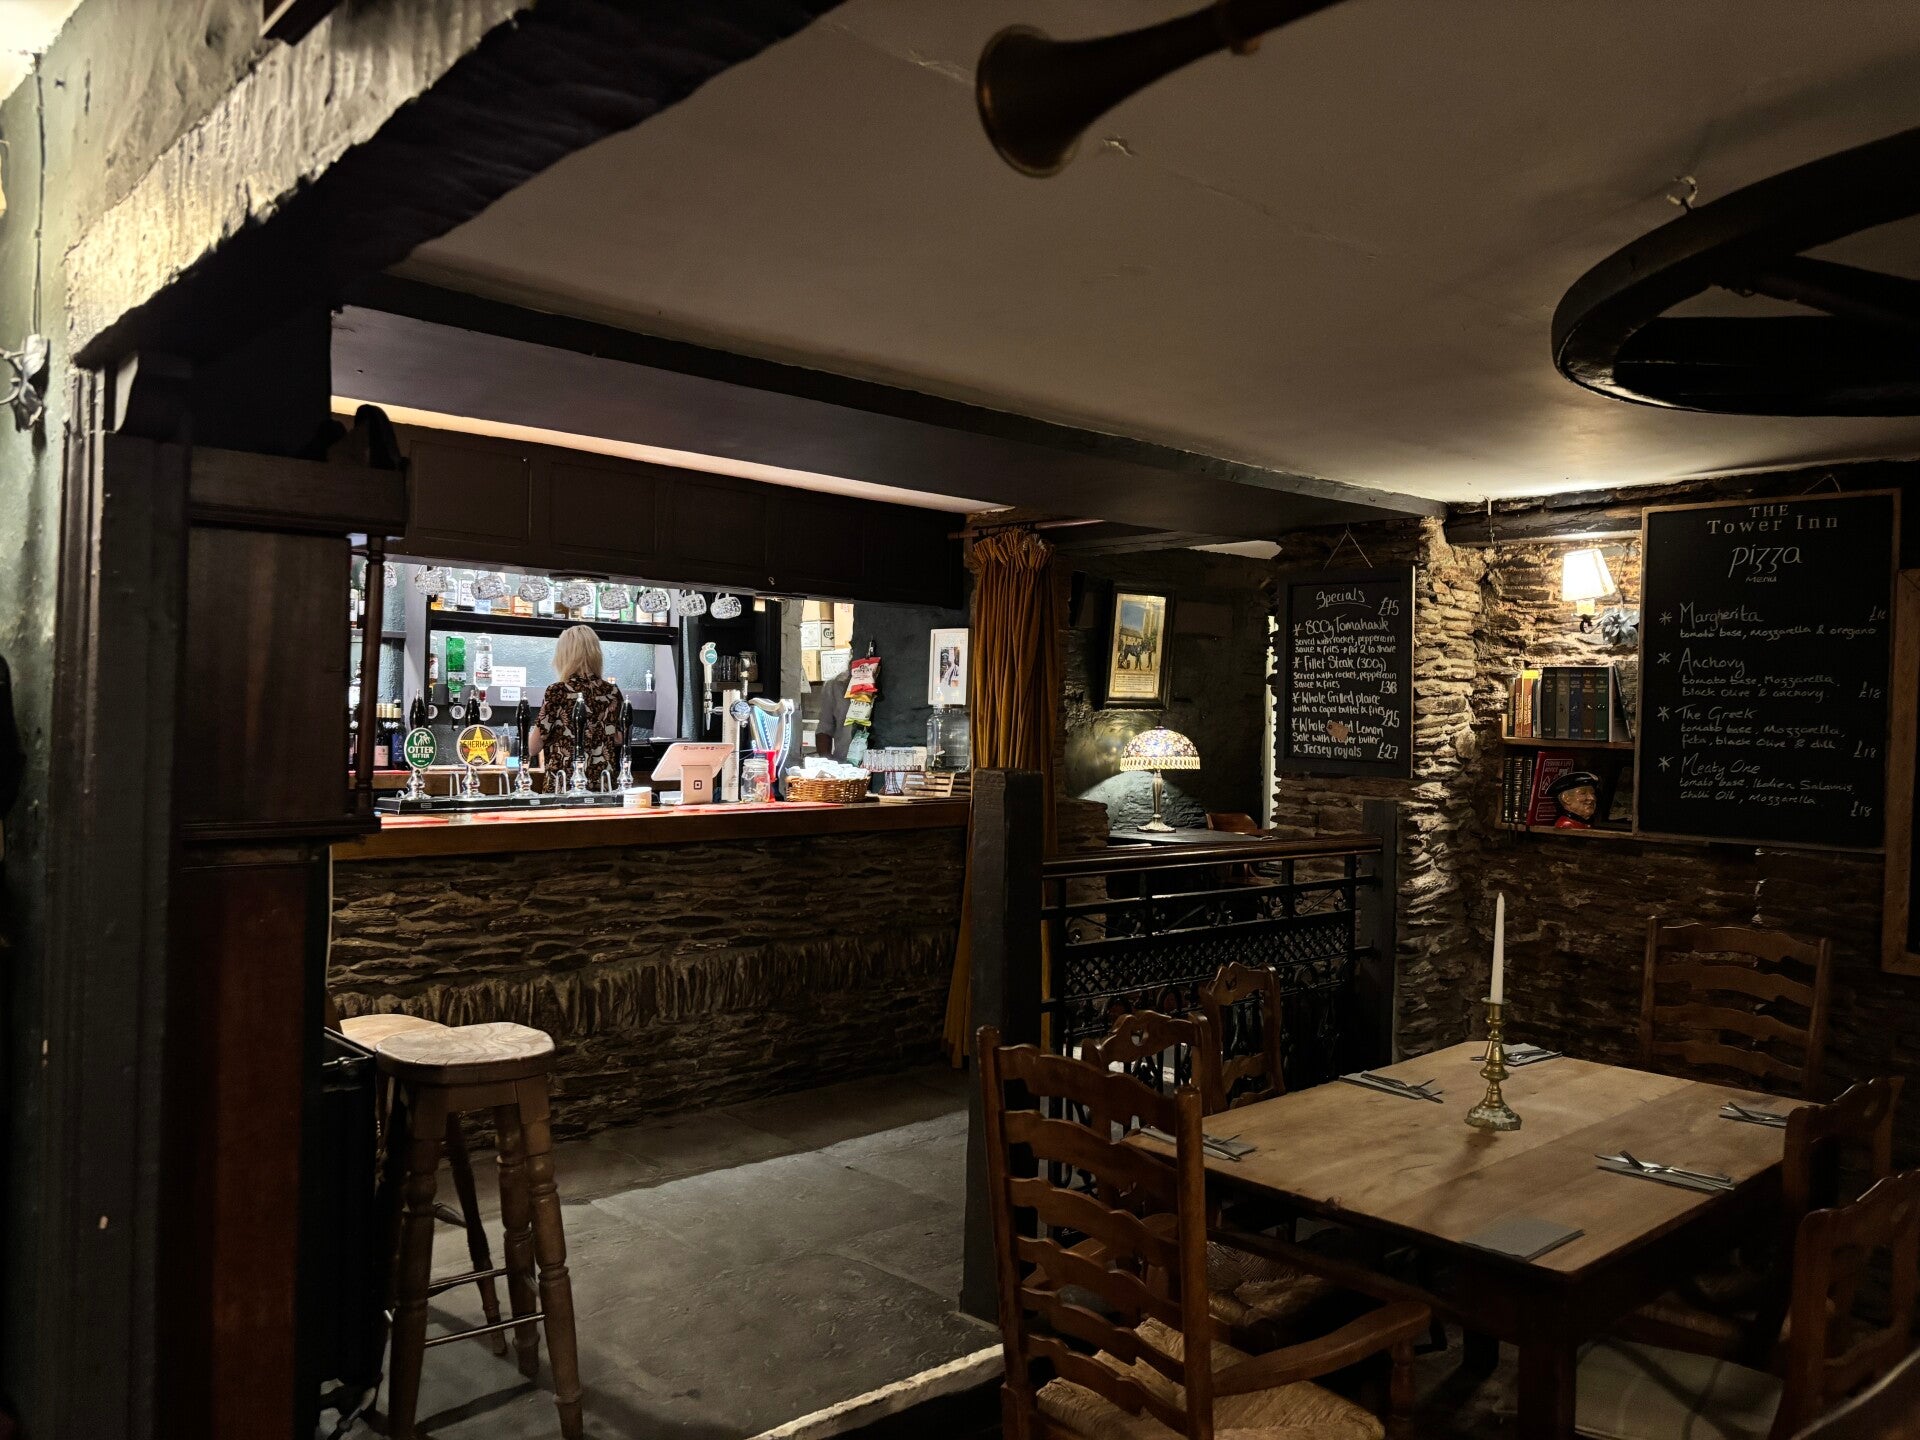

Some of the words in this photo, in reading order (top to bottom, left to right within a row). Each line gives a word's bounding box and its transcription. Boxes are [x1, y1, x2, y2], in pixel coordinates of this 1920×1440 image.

[1749, 505, 1789, 518] THE
[1707, 519, 1782, 534] Tower
[1796, 515, 1838, 530] Inn
[1728, 544, 1804, 578] pizza
[1316, 587, 1365, 607] Specials
[1680, 602, 1765, 631] Margherita
[1306, 620, 1334, 640] 800g
[1333, 613, 1390, 633] Tomahawk
[1680, 628, 1714, 638] tomato
[1816, 624, 1824, 634] &
[1829, 628, 1878, 640] oregano
[1323, 646, 1340, 655] fries
[1348, 646, 1357, 655] for
[1360, 644, 1368, 655] 2
[1368, 645, 1375, 653] to
[1304, 656, 1326, 671] Fillet
[1328, 656, 1355, 669] Steak
[1357, 656, 1386, 672] (300g)
[1678, 648, 1745, 678] Anchovy
[1323, 680, 1340, 689] fries
[1380, 680, 1398, 694] £38
[1682, 674, 1726, 684] tomato
[1302, 692, 1326, 704] Whole
[1328, 691, 1354, 705] Grilled
[1682, 686, 1715, 696] black
[1758, 688, 1768, 696] &
[1319, 706, 1336, 717] caper
[1339, 706, 1359, 714] butter
[1675, 704, 1701, 720] The
[1708, 706, 1758, 726] Greek
[1300, 717, 1325, 732] Whole
[1356, 720, 1384, 737] Lemon
[1681, 723, 1722, 732] tomato
[1292, 732, 1310, 742] Sole
[1312, 734, 1330, 742] with
[1359, 736, 1379, 744] butter
[1716, 736, 1751, 745] black
[1794, 738, 1806, 748] &
[1810, 740, 1836, 748] dill
[1304, 744, 1332, 758] Jersey
[1334, 746, 1362, 759] royals
[1377, 742, 1398, 759] £27
[1853, 740, 1876, 758] £18
[1681, 752, 1725, 780] Meaty
[1730, 760, 1760, 774] One
[1680, 778, 1713, 787] tomato
[1850, 800, 1873, 817] £18
